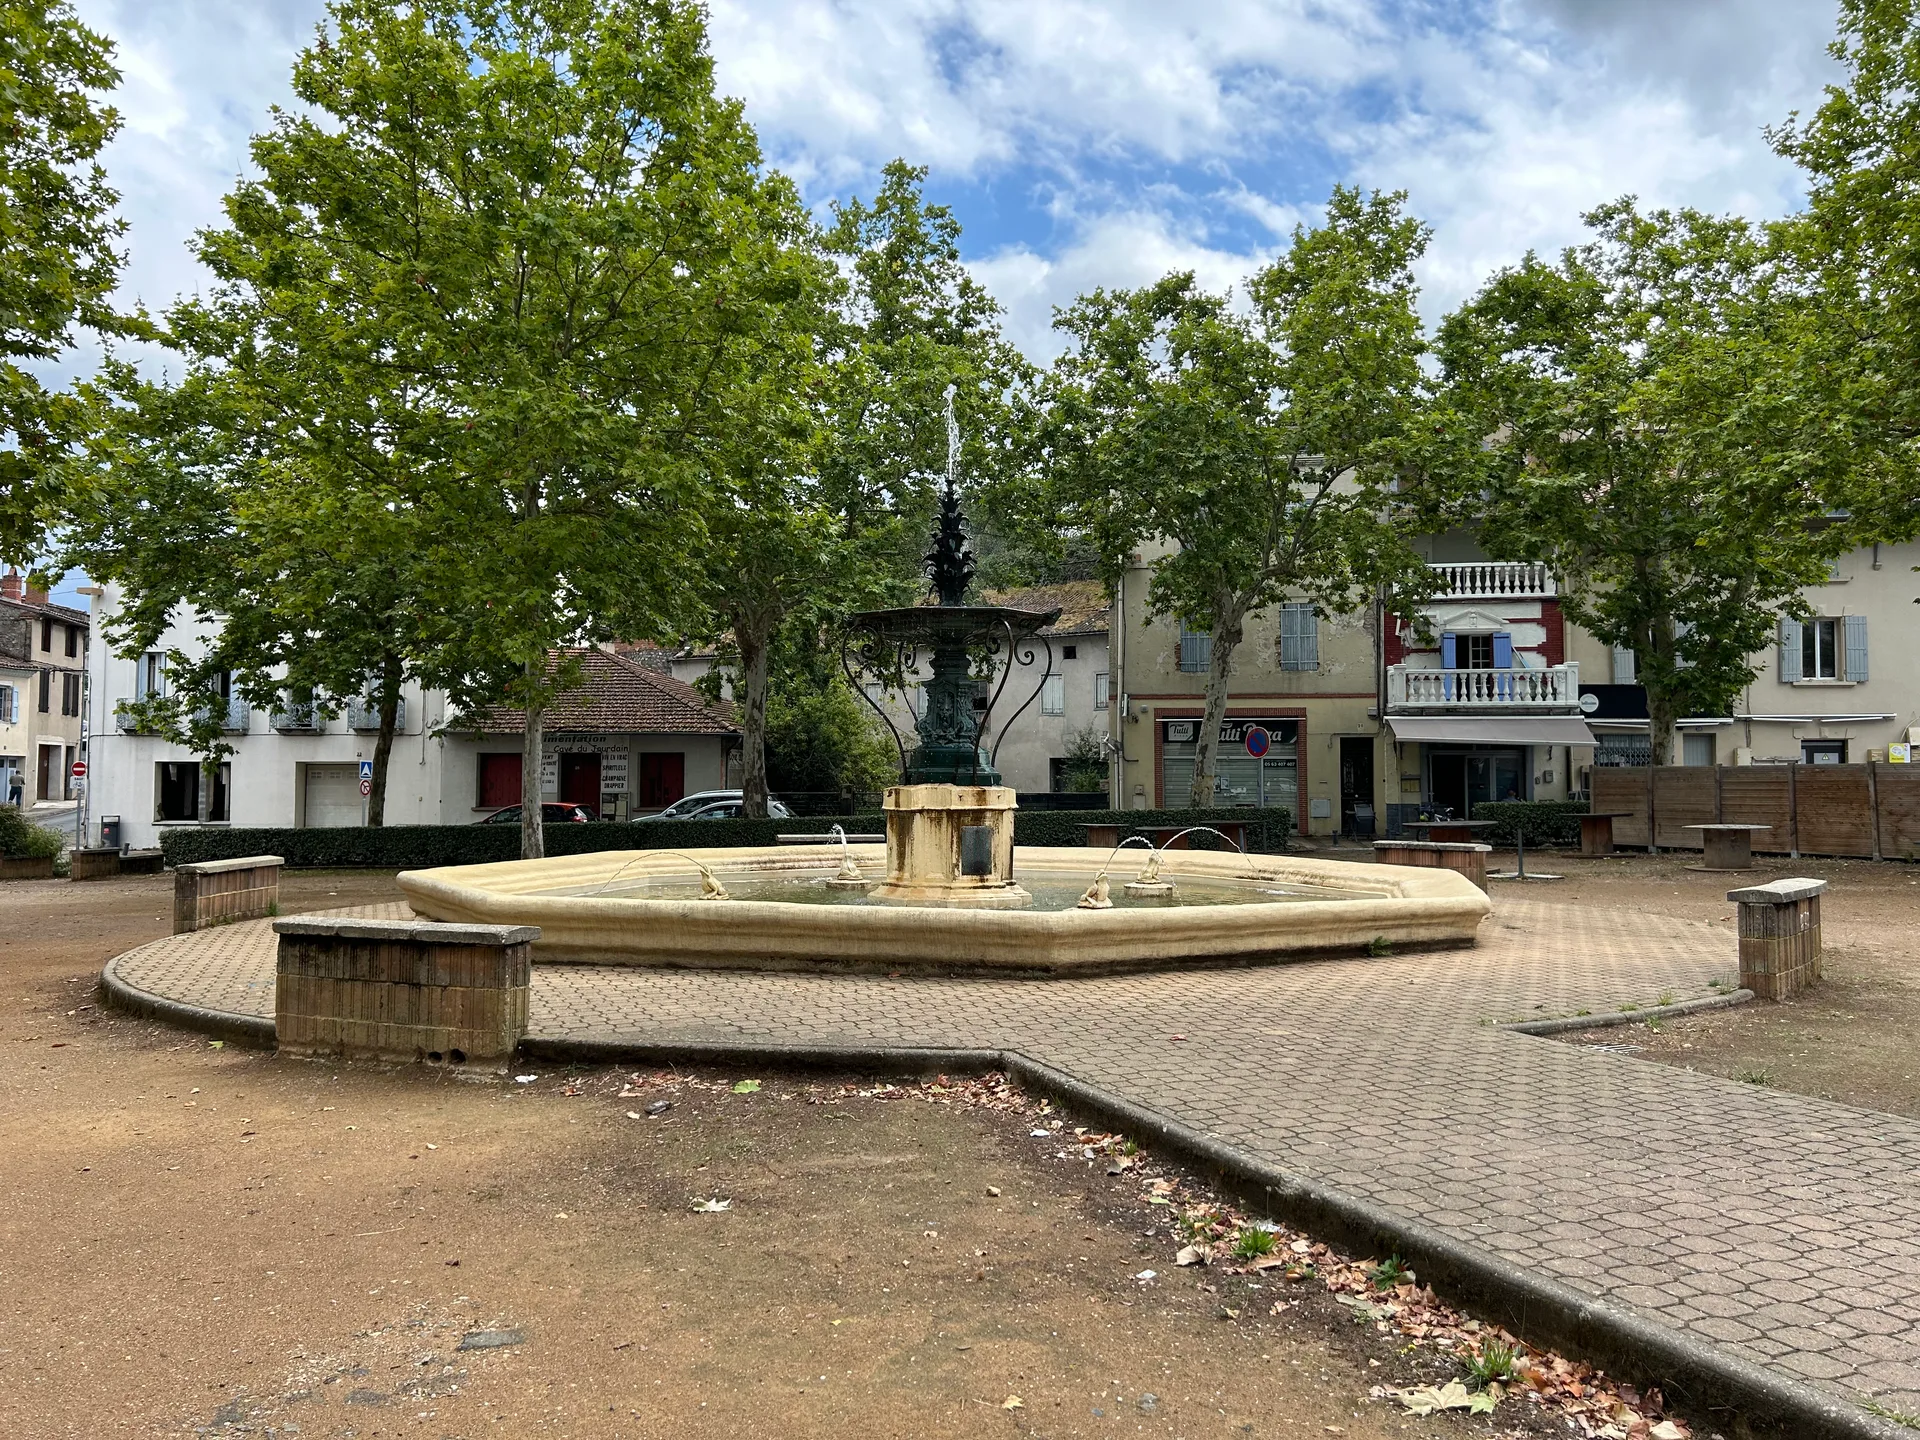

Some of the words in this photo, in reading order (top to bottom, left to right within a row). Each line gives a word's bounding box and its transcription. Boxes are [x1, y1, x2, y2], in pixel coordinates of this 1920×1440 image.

[1169, 724, 1189, 734] Tutti
[543, 735, 607, 743] imentation
[553, 745, 574, 753] Cave
[577, 745, 588, 753] du
[591, 745, 629, 753] Jourdain
